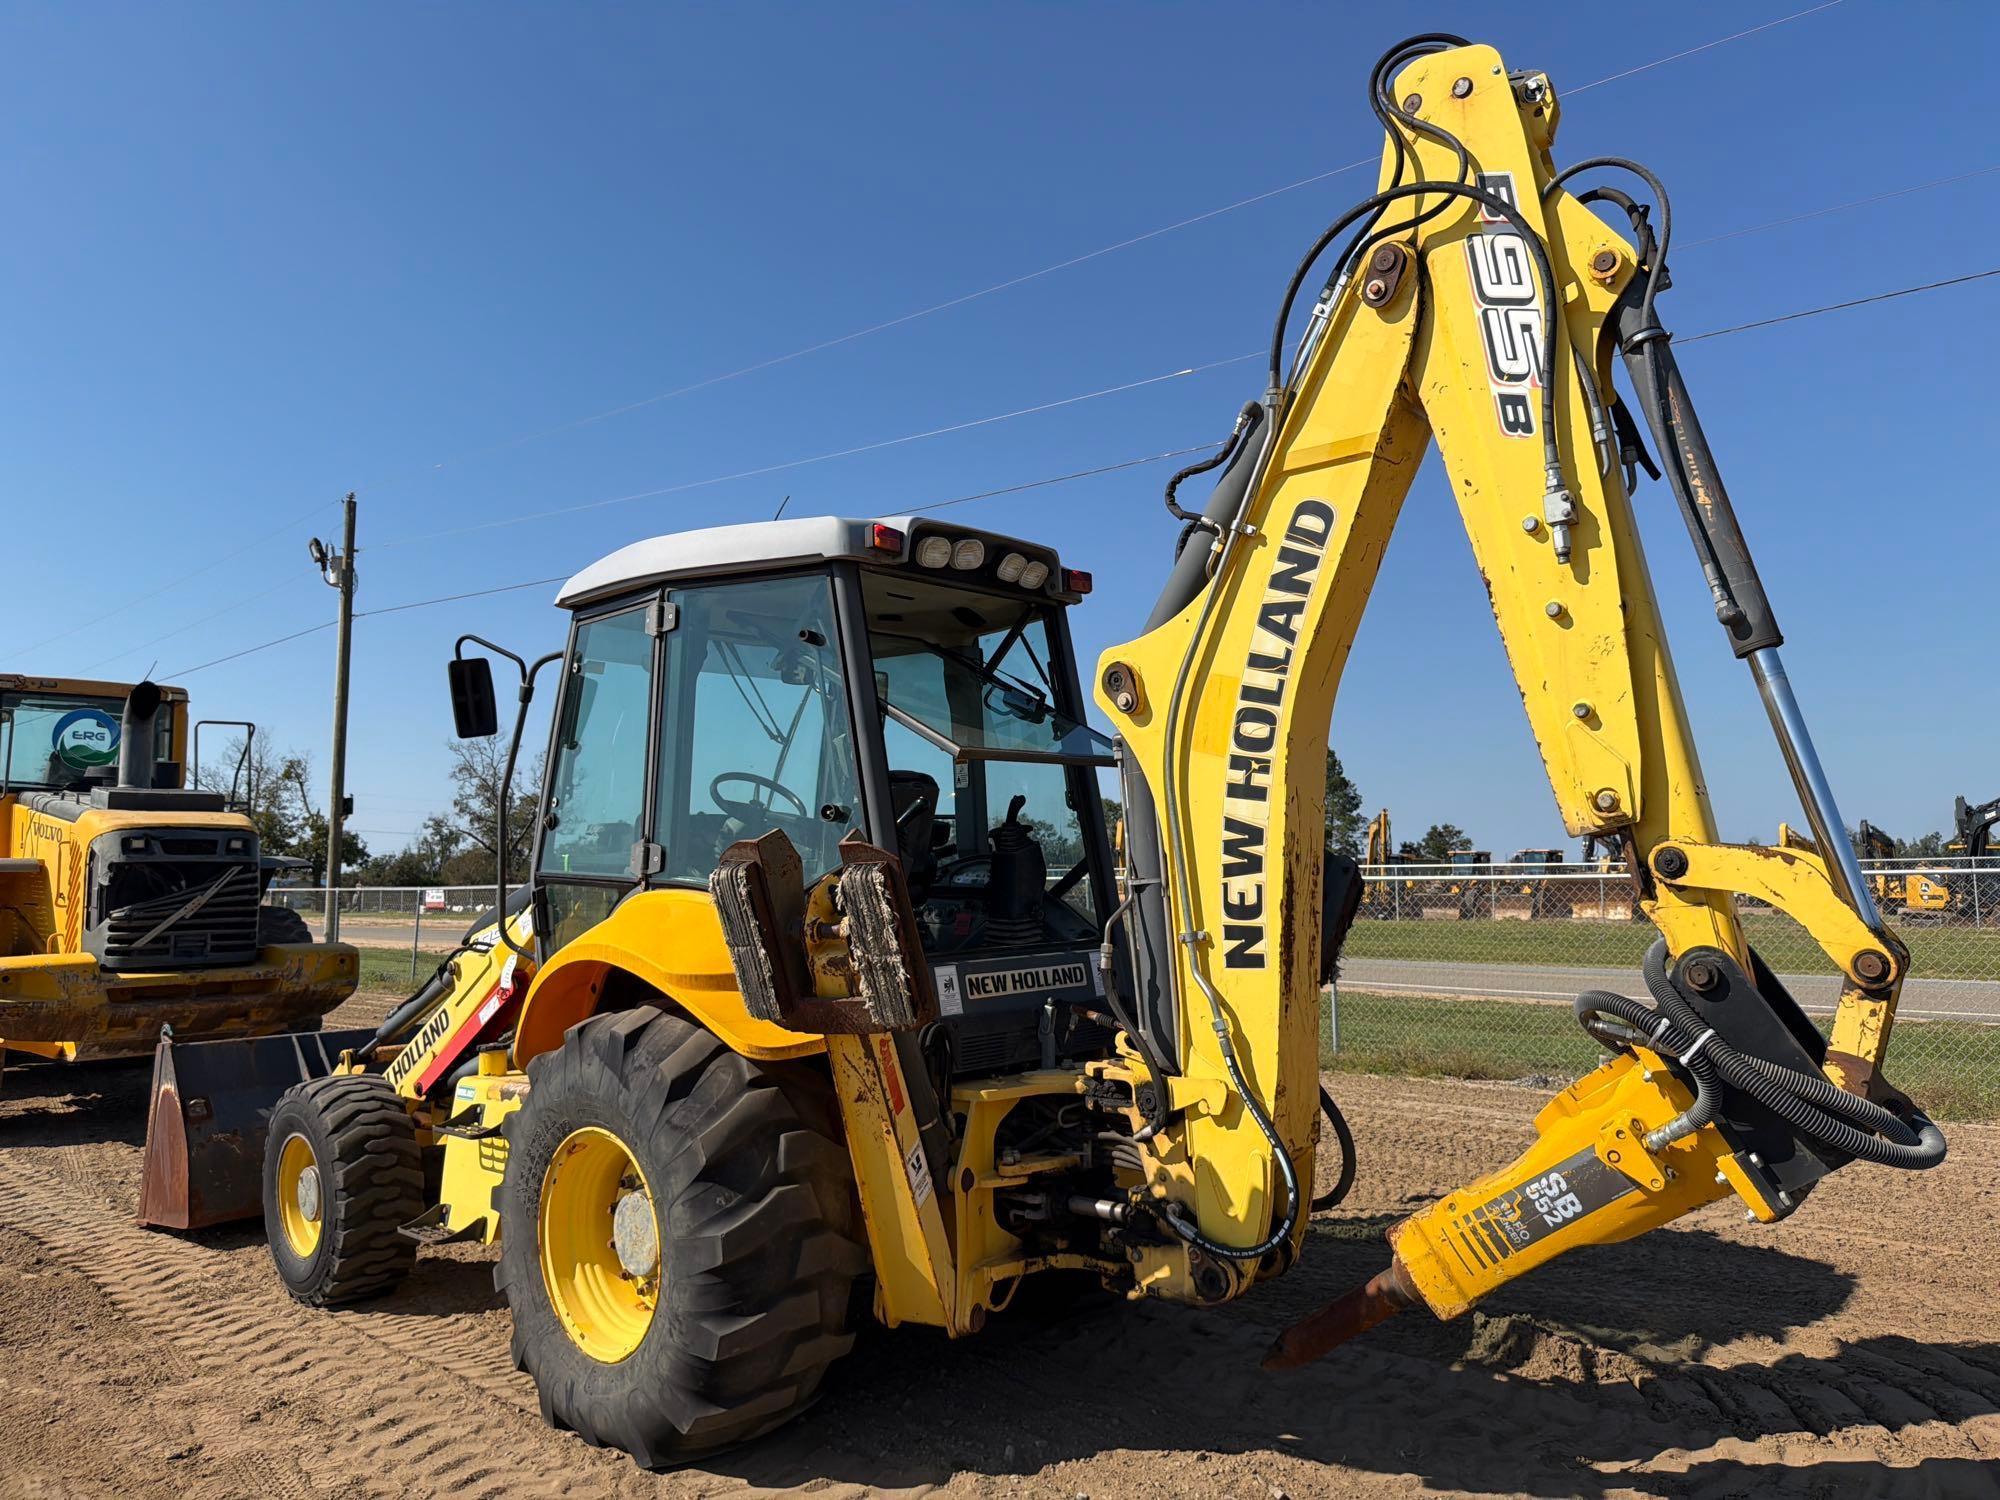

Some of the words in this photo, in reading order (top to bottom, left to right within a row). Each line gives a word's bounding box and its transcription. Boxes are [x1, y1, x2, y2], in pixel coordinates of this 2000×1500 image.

[1226, 500, 1336, 801] HOLLAND
[72, 731, 106, 741] ERG
[33, 821, 63, 842] VOLVO
[1223, 816, 1265, 968] NEW
[968, 974, 1007, 996] NEW
[1011, 966, 1084, 990] HOLLAND
[392, 1008, 450, 1084] HOLLAND
[1525, 1182, 1563, 1228] 552
[1541, 1172, 1583, 1219] SB
